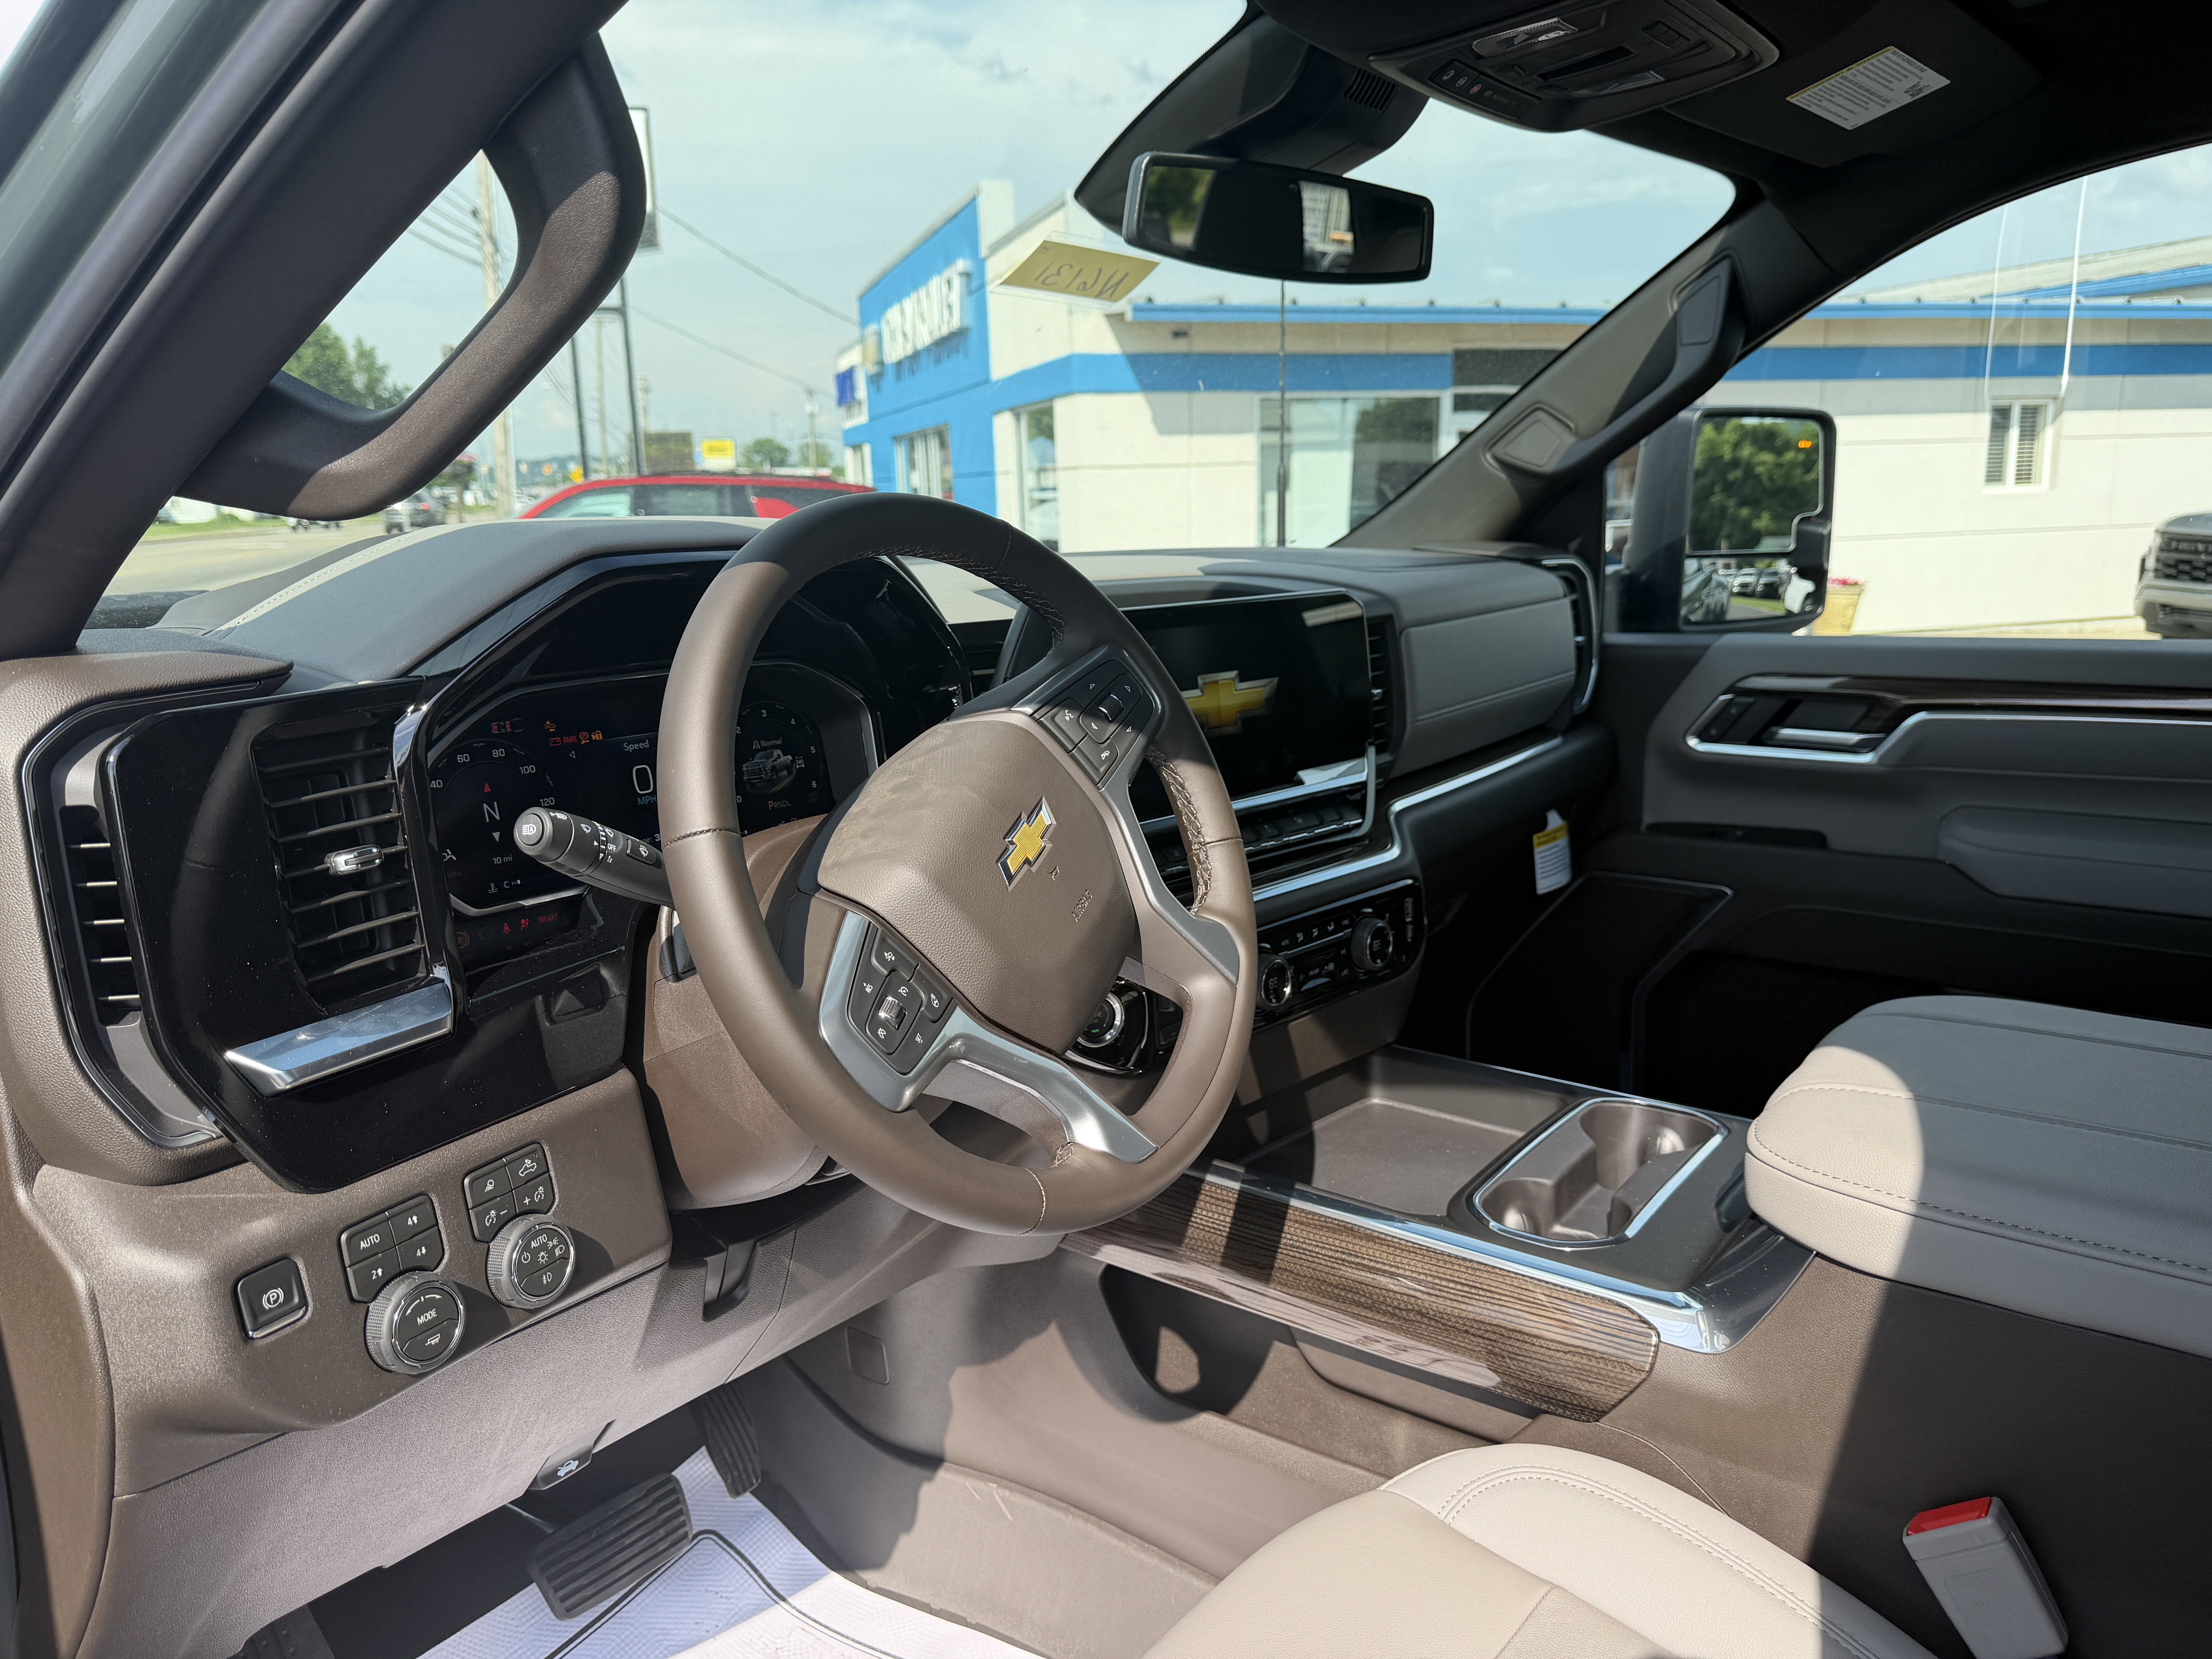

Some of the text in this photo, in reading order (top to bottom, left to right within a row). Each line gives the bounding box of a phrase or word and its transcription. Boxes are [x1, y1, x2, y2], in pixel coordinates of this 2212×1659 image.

[563, 735, 578, 744] PARK
[761, 737, 782, 747] Normal
[623, 740, 649, 752] Speed
[493, 749, 505, 757] 80
[457, 754, 470, 763] 60
[519, 765, 536, 775] 100
[430, 780, 443, 788] 40
[633, 765, 654, 794] 0
[539, 797, 555, 807] 120
[637, 795, 656, 805] MPH
[483, 802, 500, 822] N
[608, 843, 617, 851] OFF
[503, 854, 513, 862] mi
[607, 855, 613, 864] 1x
[1072, 890, 1093, 922] AIRBAG
[538, 913, 558, 924] BRAKE
[360, 1234, 380, 1250] AUTO
[531, 1234, 547, 1249] AUTO
[417, 1308, 438, 1325] MODE
